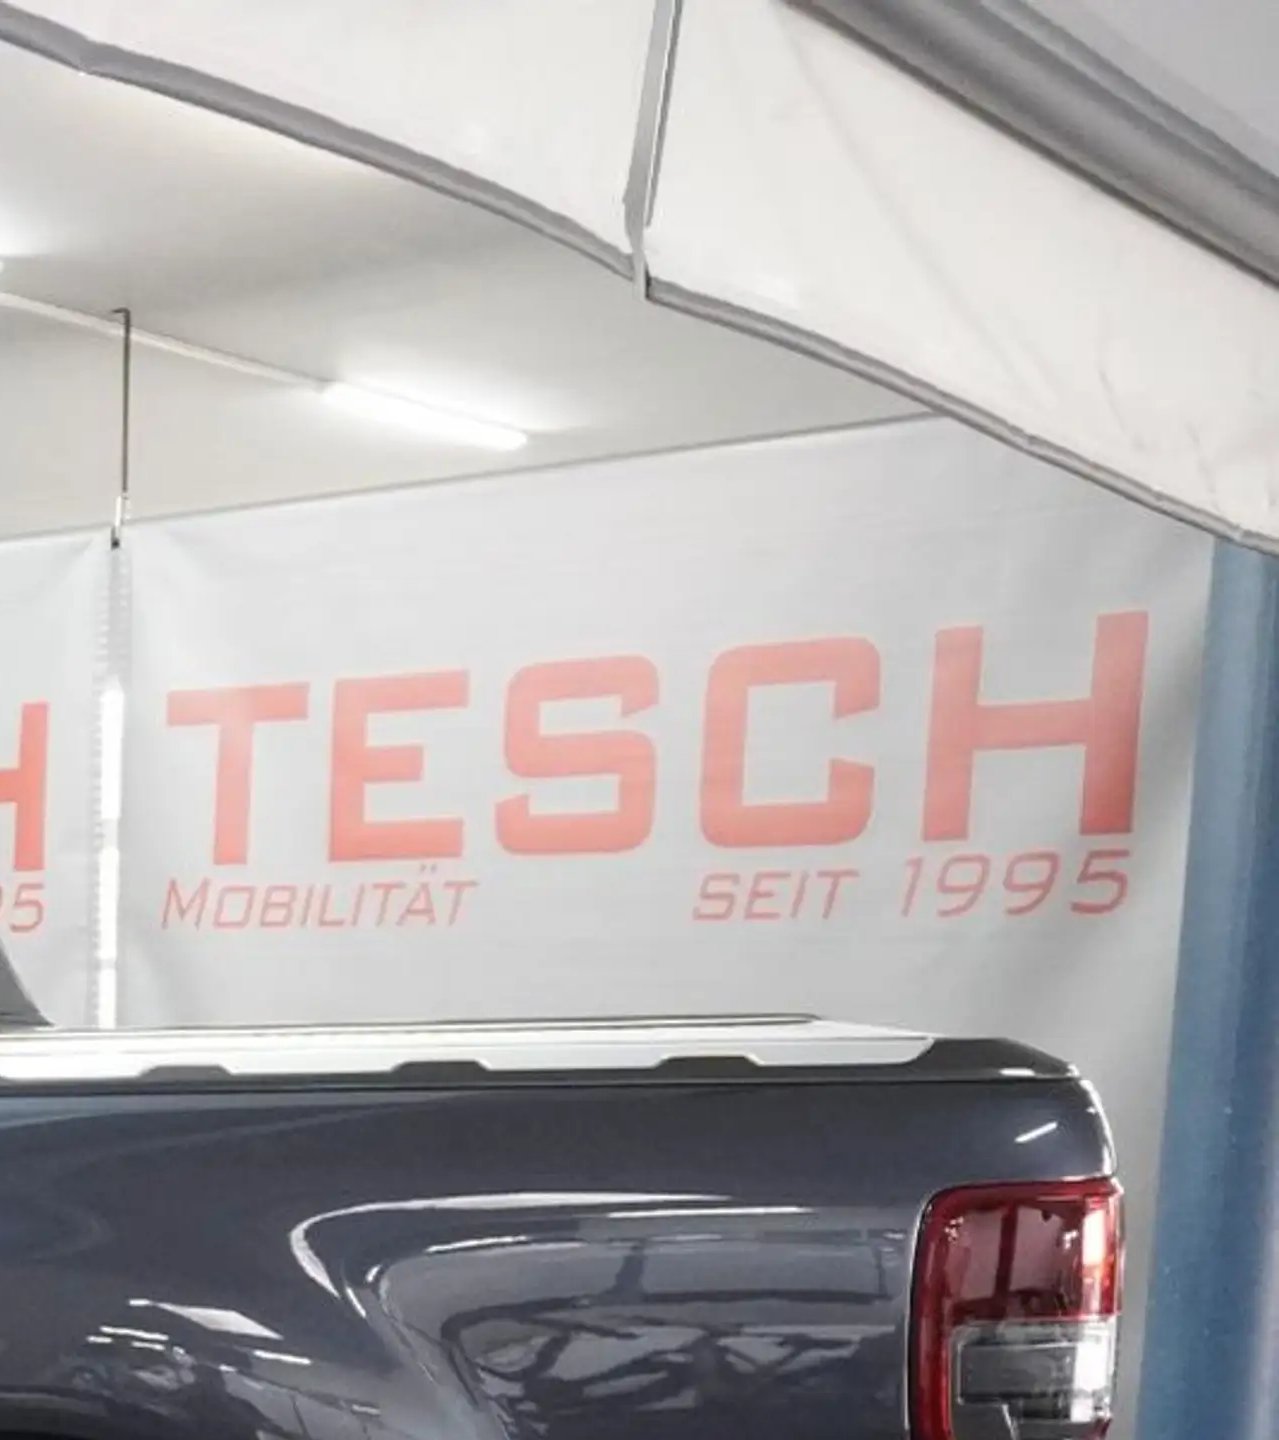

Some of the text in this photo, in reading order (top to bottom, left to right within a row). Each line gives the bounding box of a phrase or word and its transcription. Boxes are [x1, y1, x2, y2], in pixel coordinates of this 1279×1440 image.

[166, 609, 1150, 866] TESCH
[692, 869, 860, 921] SEIT
[900, 848, 1132, 917] 1995
